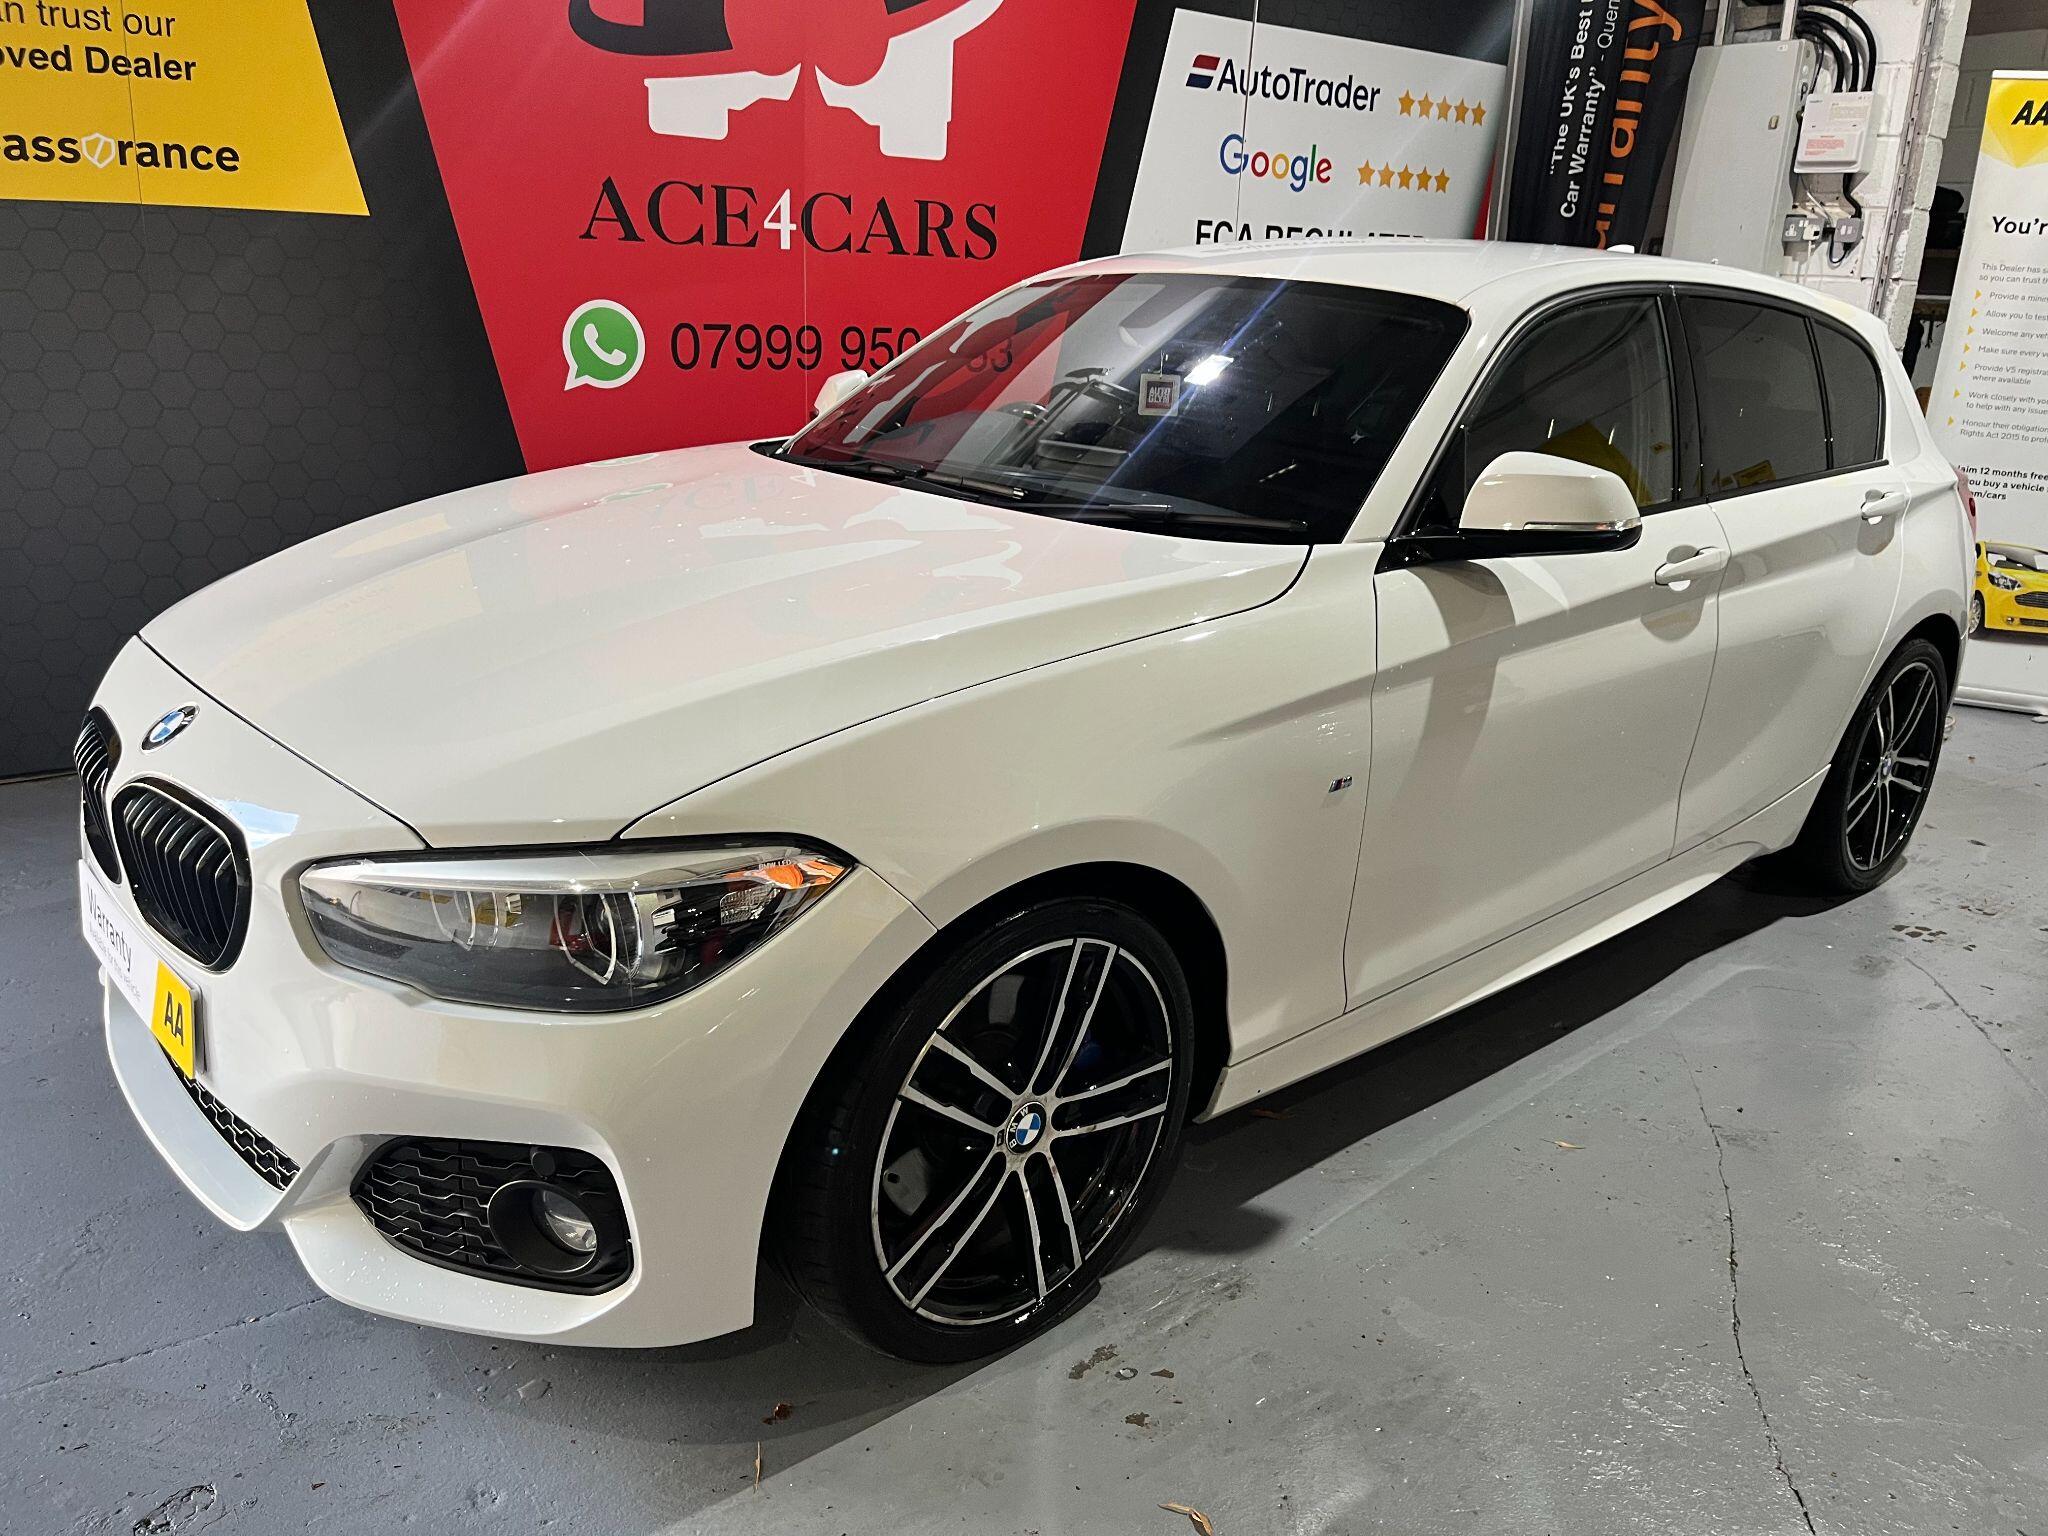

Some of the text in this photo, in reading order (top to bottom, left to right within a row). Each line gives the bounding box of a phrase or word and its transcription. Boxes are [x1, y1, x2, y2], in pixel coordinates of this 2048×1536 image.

[0, 0, 176, 38] n trust our
[1570, 9, 1593, 60] Best
[0, 45, 197, 81] ved Dealer
[1217, 59, 1381, 112] AutoTrader
[1560, 66, 1581, 117] UK's
[1219, 133, 1332, 192] Google
[1560, 181, 1580, 218] Car
[579, 176, 999, 260] ACE4CARS
[1982, 262, 1997, 271] This
[2000, 263, 2025, 273] Dealer
[2027, 265, 2041, 274] has
[1990, 275, 2005, 283] you
[2022, 276, 2041, 284] trust
[1990, 291, 2020, 301] Provide
[1985, 309, 2008, 318] Allow
[2009, 312, 2024, 320] you
[2025, 312, 2034, 320] to
[1982, 327, 2019, 337] Welcome
[2020, 331, 2035, 339] any
[670, 321, 822, 371] 07999
[1978, 345, 2000, 354] Make
[2001, 348, 2018, 356] sure
[2019, 350, 2041, 358] every
[1974, 363, 2004, 373] Provide
[1972, 375, 2032, 386] where available
[1968, 391, 1989, 401] Work
[1990, 393, 2018, 403] closely
[2019, 395, 2036, 404] with
[1966, 401, 1975, 409] to
[1975, 402, 1993, 411] help
[1994, 403, 2011, 412] with
[2012, 406, 2027, 415] any
[1962, 419, 1992, 428] Honour
[1992, 421, 2010, 430] their
[1960, 428, 1985, 438] Rights
[1985, 431, 2000, 439] Act
[2000, 432, 2020, 441] 2015
[2021, 434, 2030, 442] to
[1980, 467, 1990, 475] 12
[1992, 468, 2029, 480] months
[1983, 479, 2001, 490] buy
[2010, 482, 2045, 493] vehicle
[87, 883, 133, 973] Warranty
[164, 990, 185, 1048] AA
[1009, 1106, 1028, 1148] BMW
